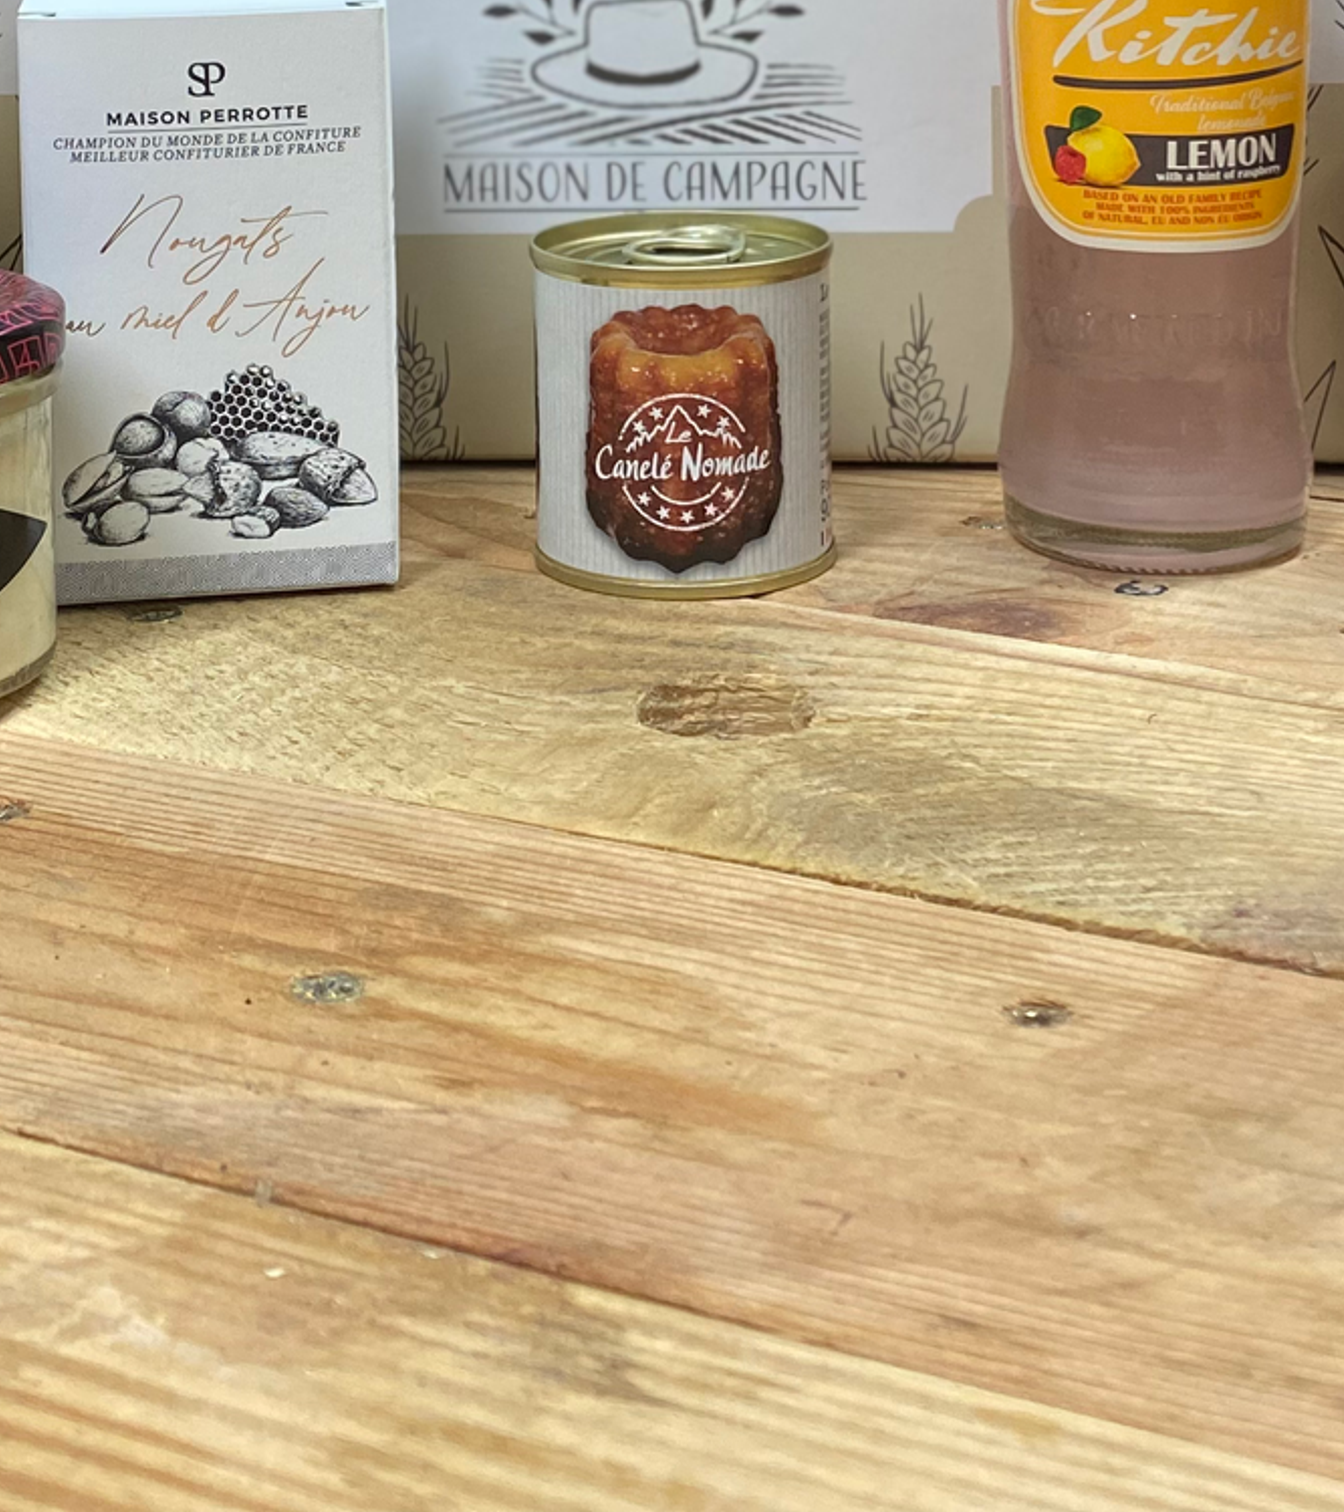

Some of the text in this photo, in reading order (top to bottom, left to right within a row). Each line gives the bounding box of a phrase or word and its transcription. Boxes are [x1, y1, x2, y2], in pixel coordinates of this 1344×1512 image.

[106, 104, 309, 127] MAISON PERROTTE
[52, 126, 362, 151] CHAMPION DU MONDE DE LA CONFITURE
[69, 140, 346, 164] MEILLEUR CONFITURIER DE FRANCE
[1166, 133, 1276, 170] LEMON
[443, 158, 869, 204] MAISON DE CAMPAGNE
[1156, 164, 1281, 182] with a hint of raspberry
[100, 193, 329, 286] Nougats
[120, 290, 208, 340] miel
[665, 421, 692, 444] Le
[595, 442, 771, 482] Canelé Nomade
